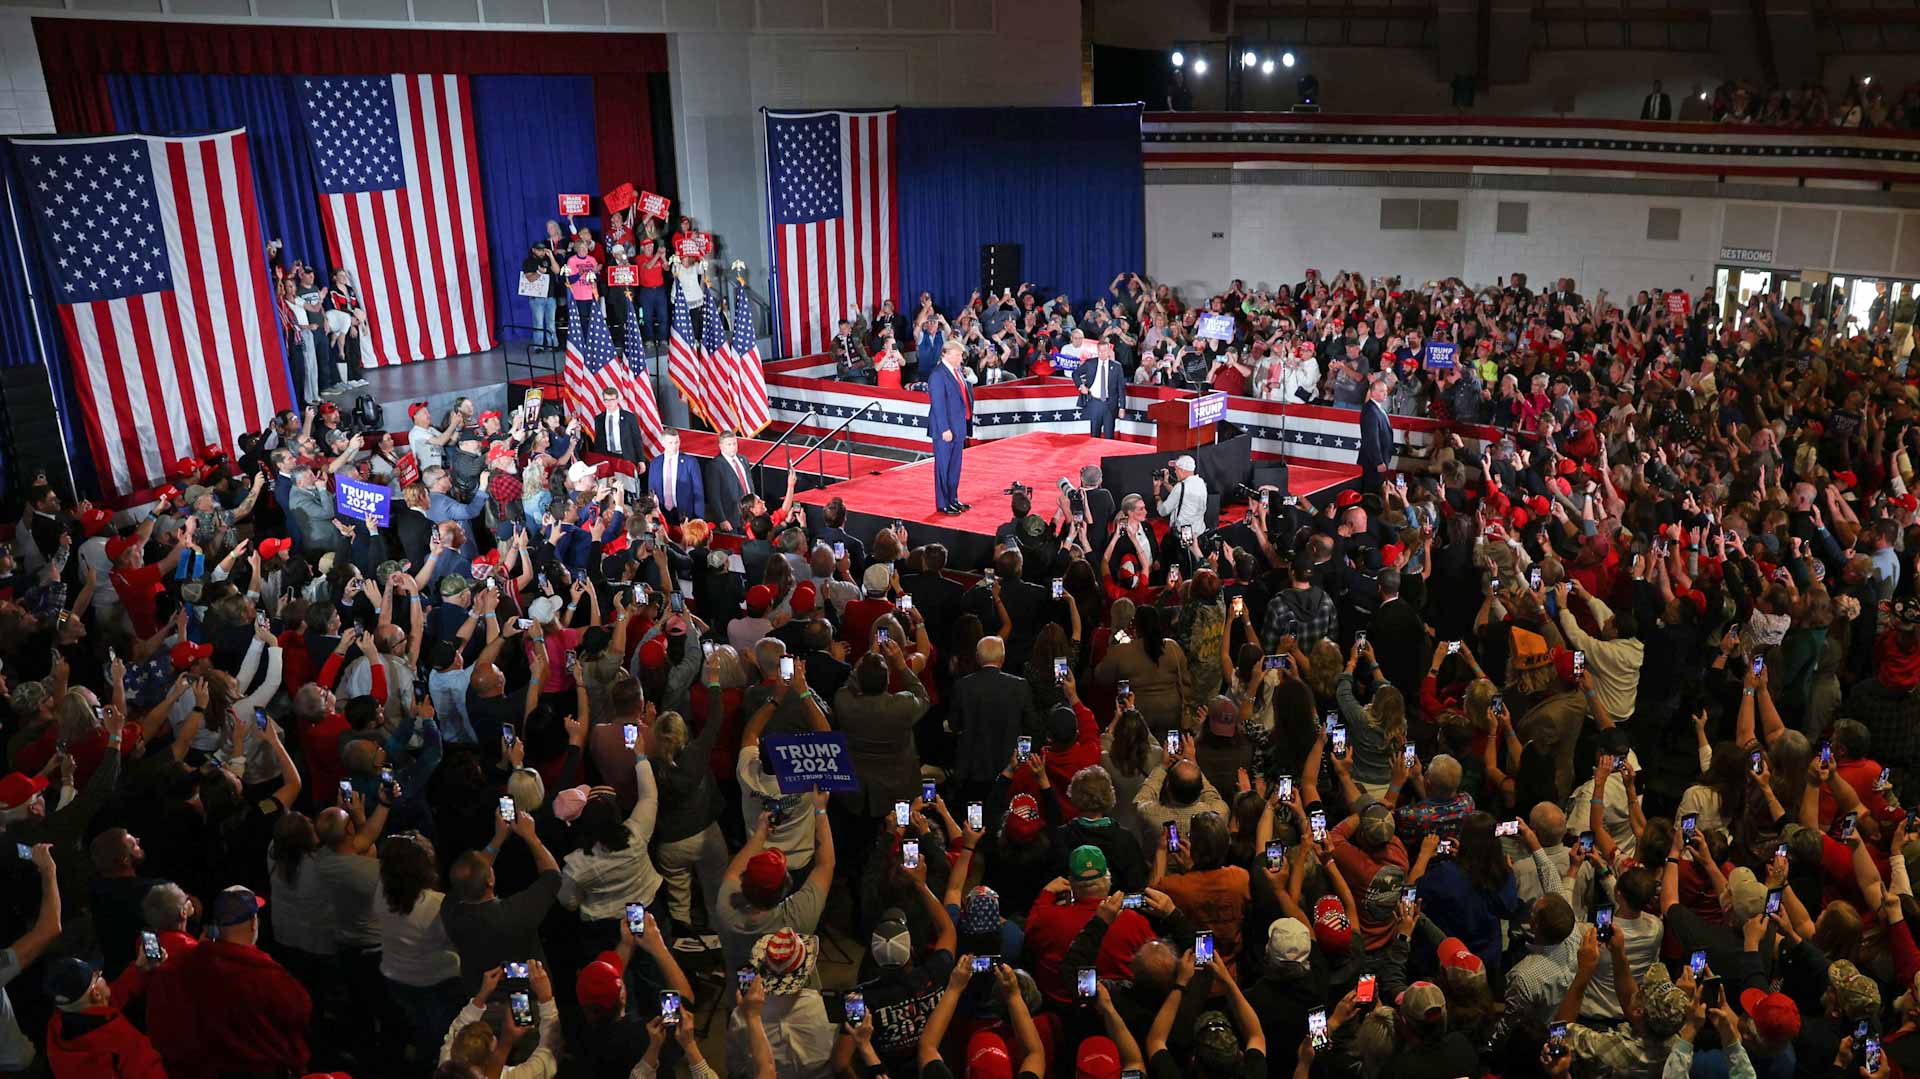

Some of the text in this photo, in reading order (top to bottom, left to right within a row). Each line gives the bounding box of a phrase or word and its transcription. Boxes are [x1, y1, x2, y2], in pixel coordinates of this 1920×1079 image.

[1720, 248, 1772, 262] RESTROOMS
[1204, 318, 1230, 328] TRUMP
[1432, 353, 1449, 361] 2024
[1194, 402, 1223, 419] TRUMP
[341, 483, 384, 504] TRUMP
[346, 496, 376, 512] 2024
[776, 743, 841, 760] TRUMP
[791, 758, 838, 773] 2024
[784, 775, 800, 783] TEXT
[884, 1015, 927, 1041] 202
